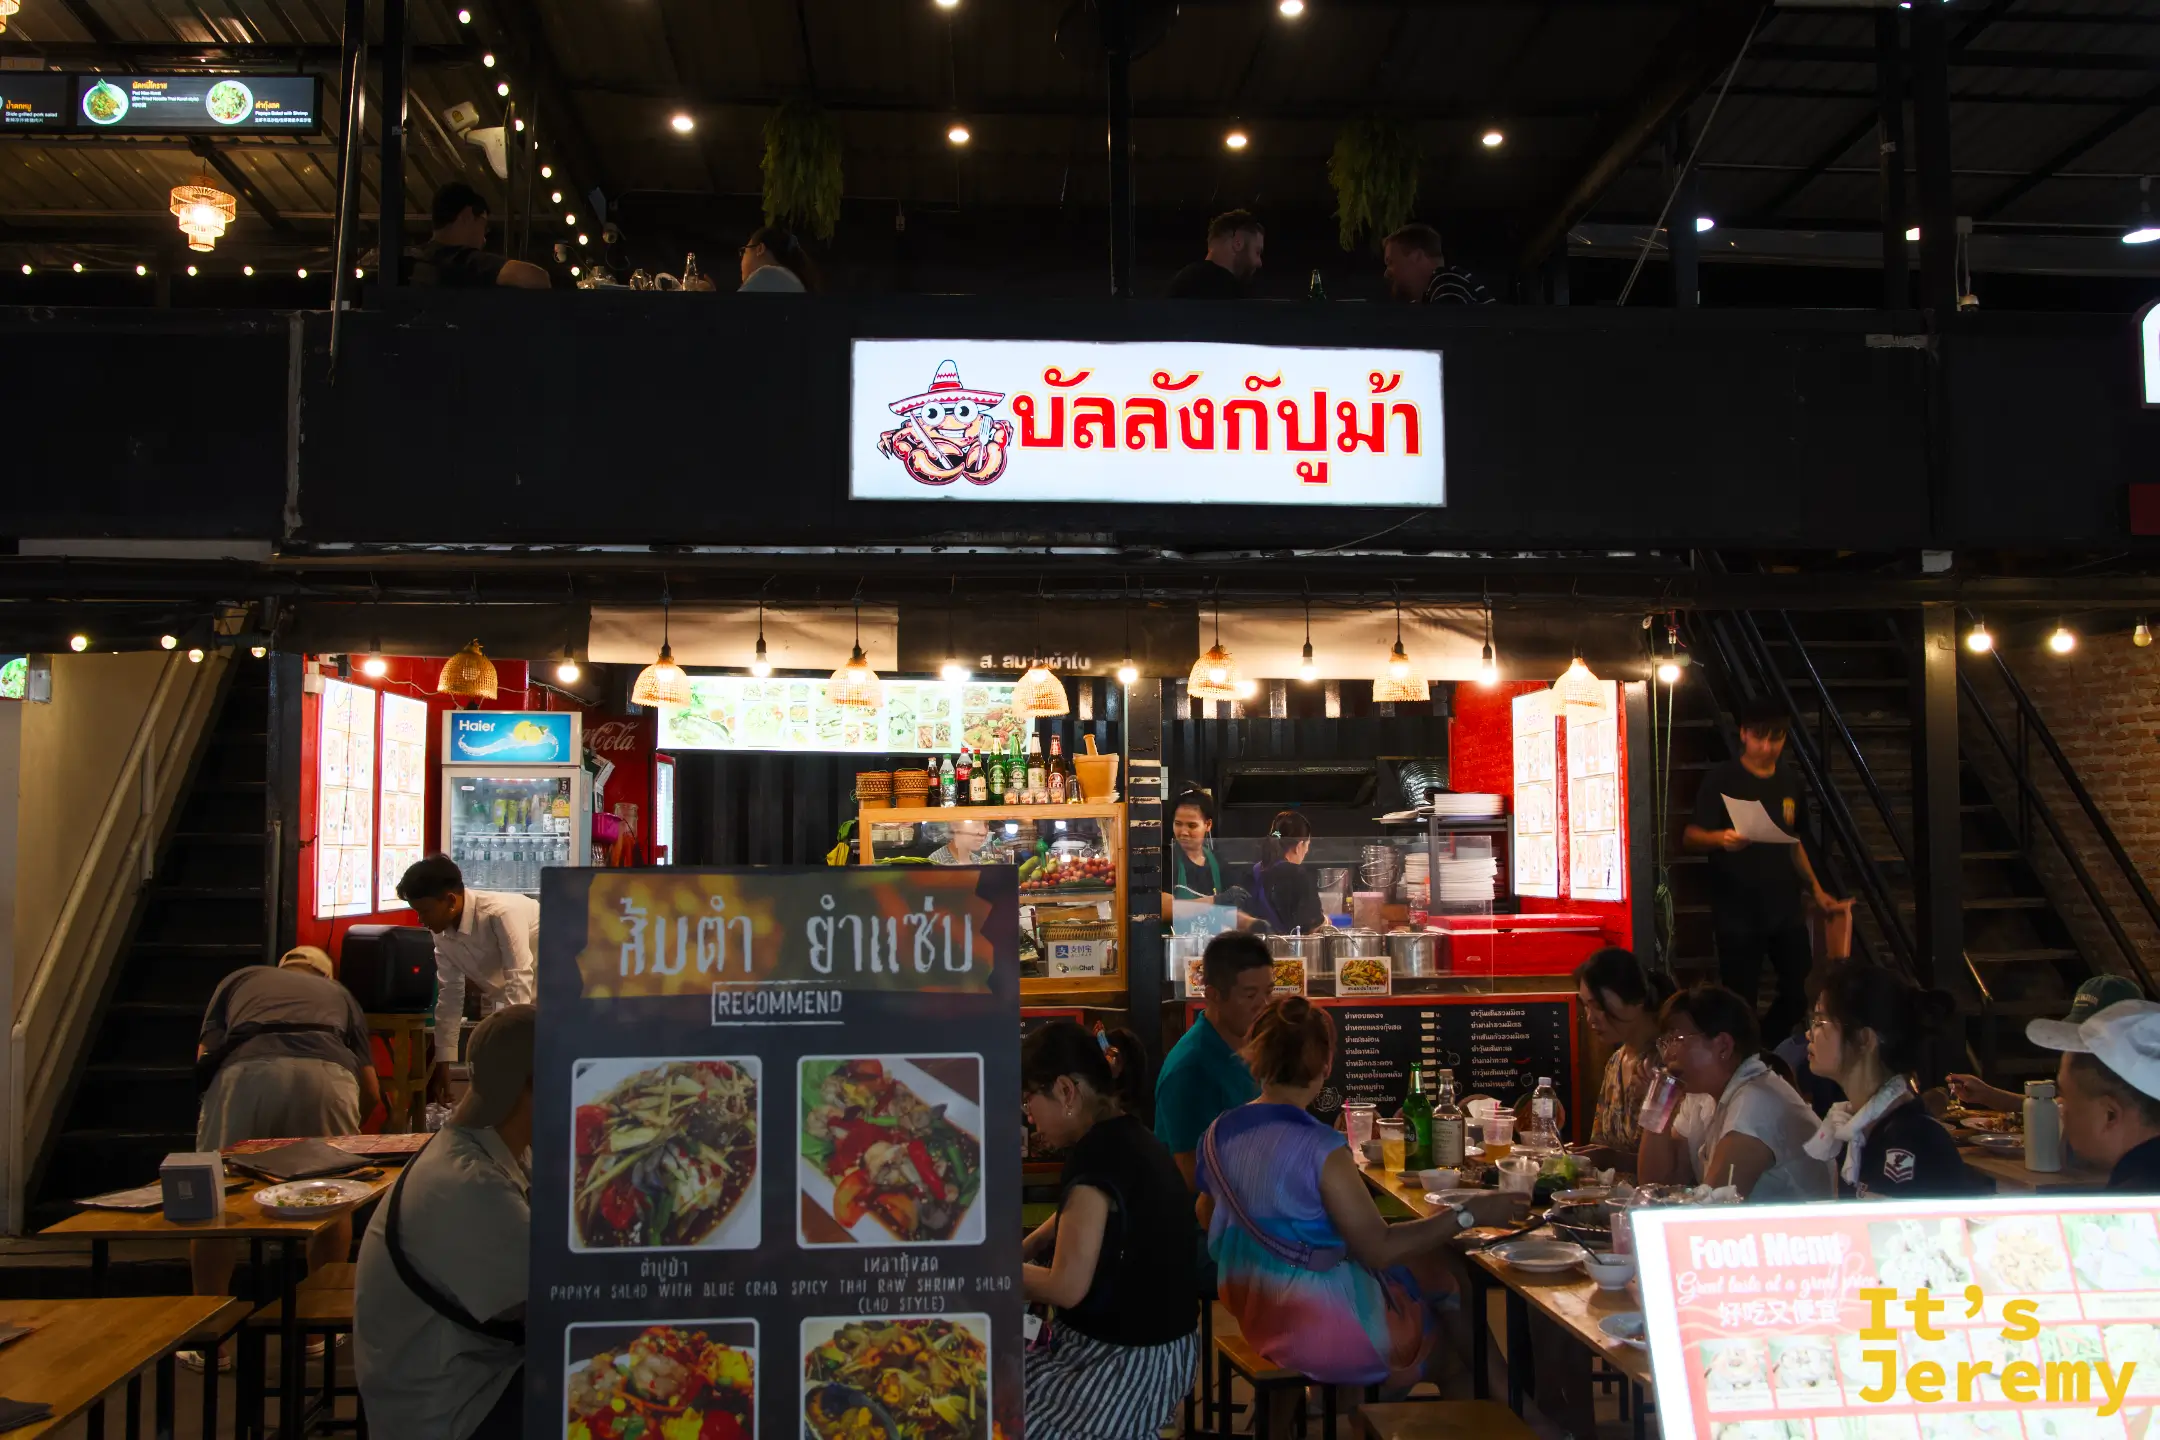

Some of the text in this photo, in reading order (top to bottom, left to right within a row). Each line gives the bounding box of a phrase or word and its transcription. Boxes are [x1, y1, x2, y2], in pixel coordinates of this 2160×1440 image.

[1011, 367, 1421, 485] บัลลังก์ปูม้า
[459, 719, 496, 732] Haier
[618, 893, 973, 977] ส้มตำ ยำแซ่บ
[718, 989, 842, 1016] RECOMMEND
[1689, 1231, 1842, 1270] Food Menu
[550, 1280, 778, 1300] PAPAYA SALAD WITH BLUE CRAB
[791, 1276, 1012, 1296] SPICY THAI RAW SHRIMP SALAD
[1676, 1271, 1725, 1304] Great
[1728, 1273, 1761, 1294] taste
[1765, 1272, 1782, 1292] at
[858, 1295, 945, 1315] (LAO STYLE)
[1718, 1299, 1841, 1328] 好吃又便宜
